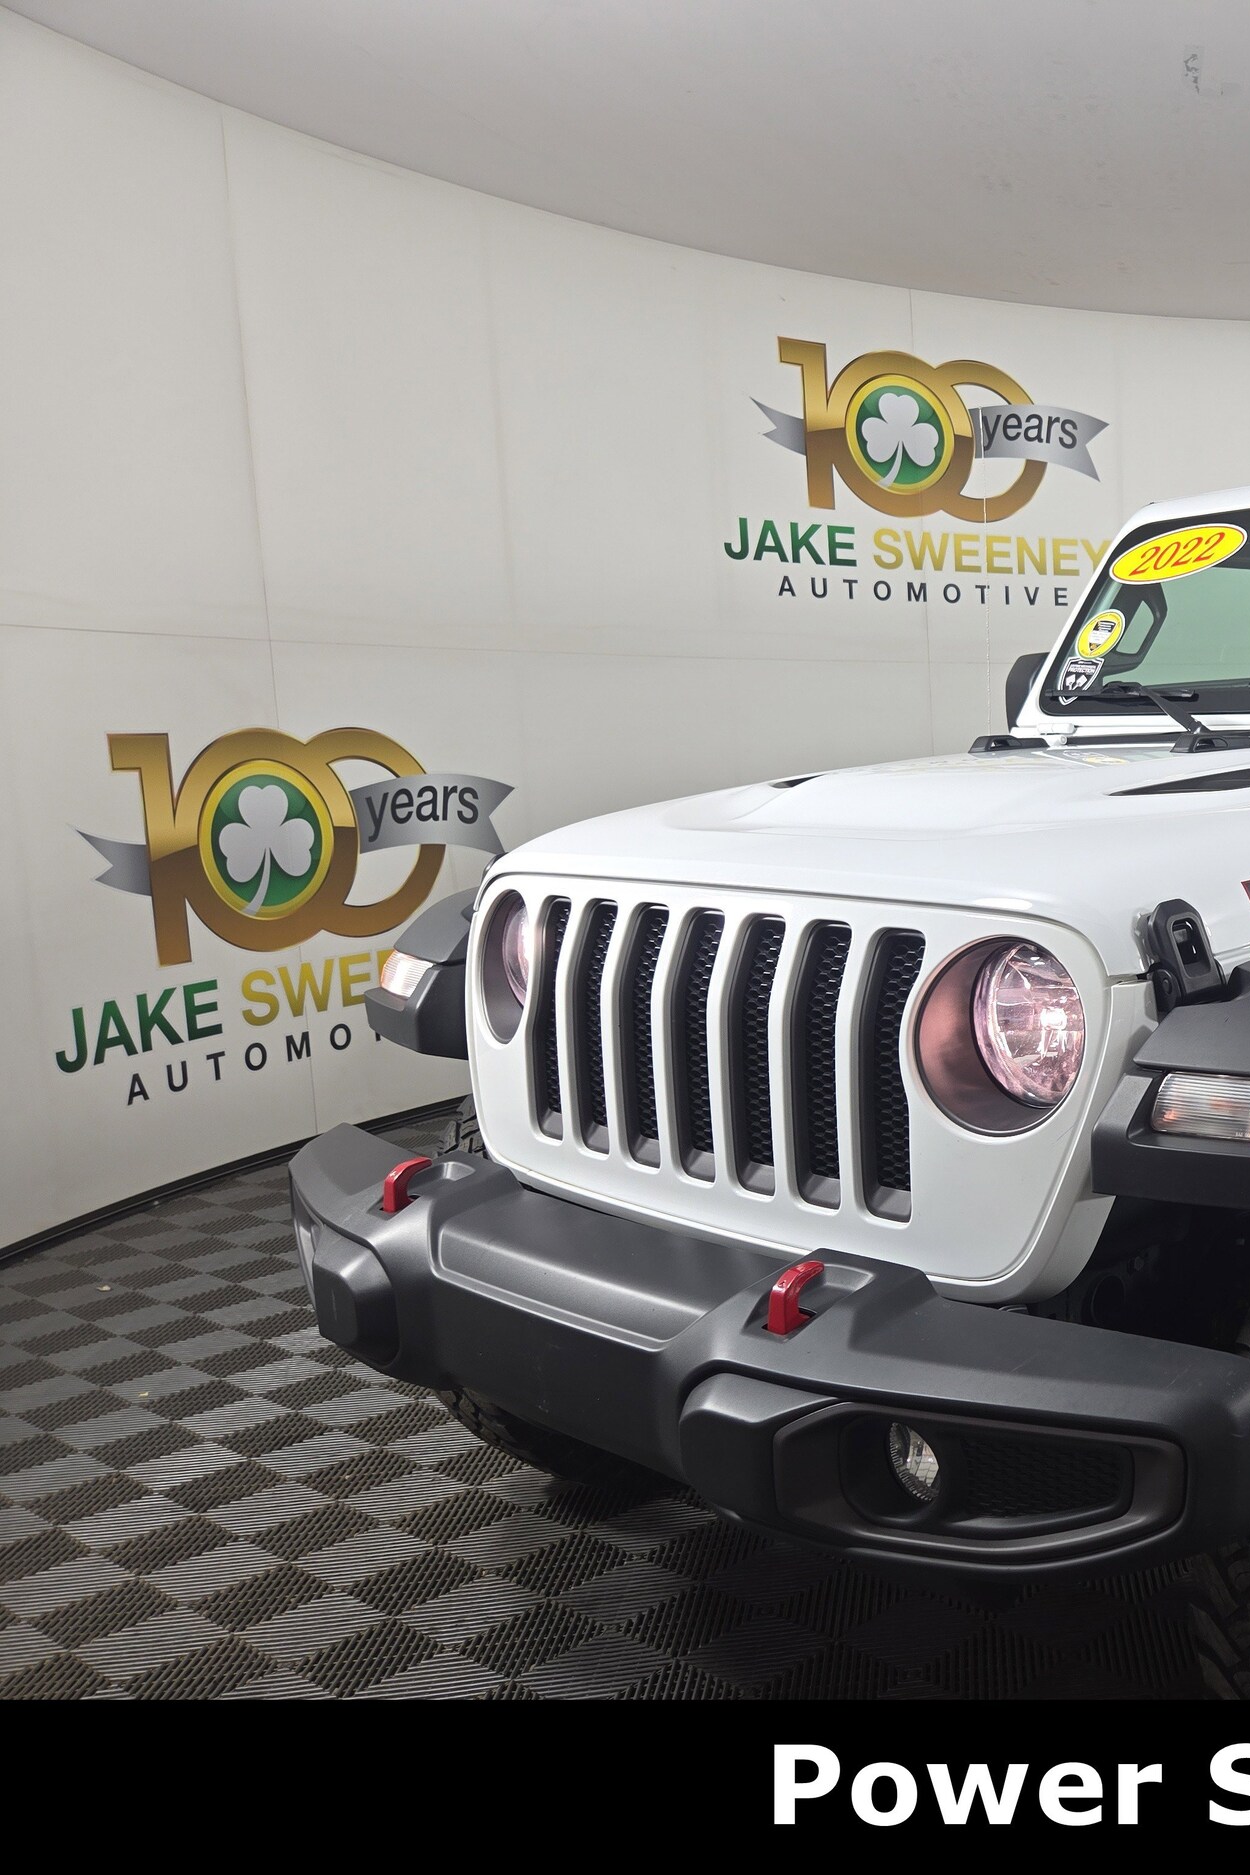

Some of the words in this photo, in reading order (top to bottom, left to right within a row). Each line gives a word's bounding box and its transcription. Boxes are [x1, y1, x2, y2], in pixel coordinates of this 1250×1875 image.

[982, 412, 1079, 451] years
[723, 517, 858, 567] JAKE
[873, 528, 1113, 577] SWEENEY
[1129, 531, 1226, 577] 2022
[778, 576, 1069, 607] AUTOMOTIVE
[365, 784, 480, 843] years
[55, 979, 224, 1073] JAKE
[126, 1023, 382, 1106] AUTOMO
